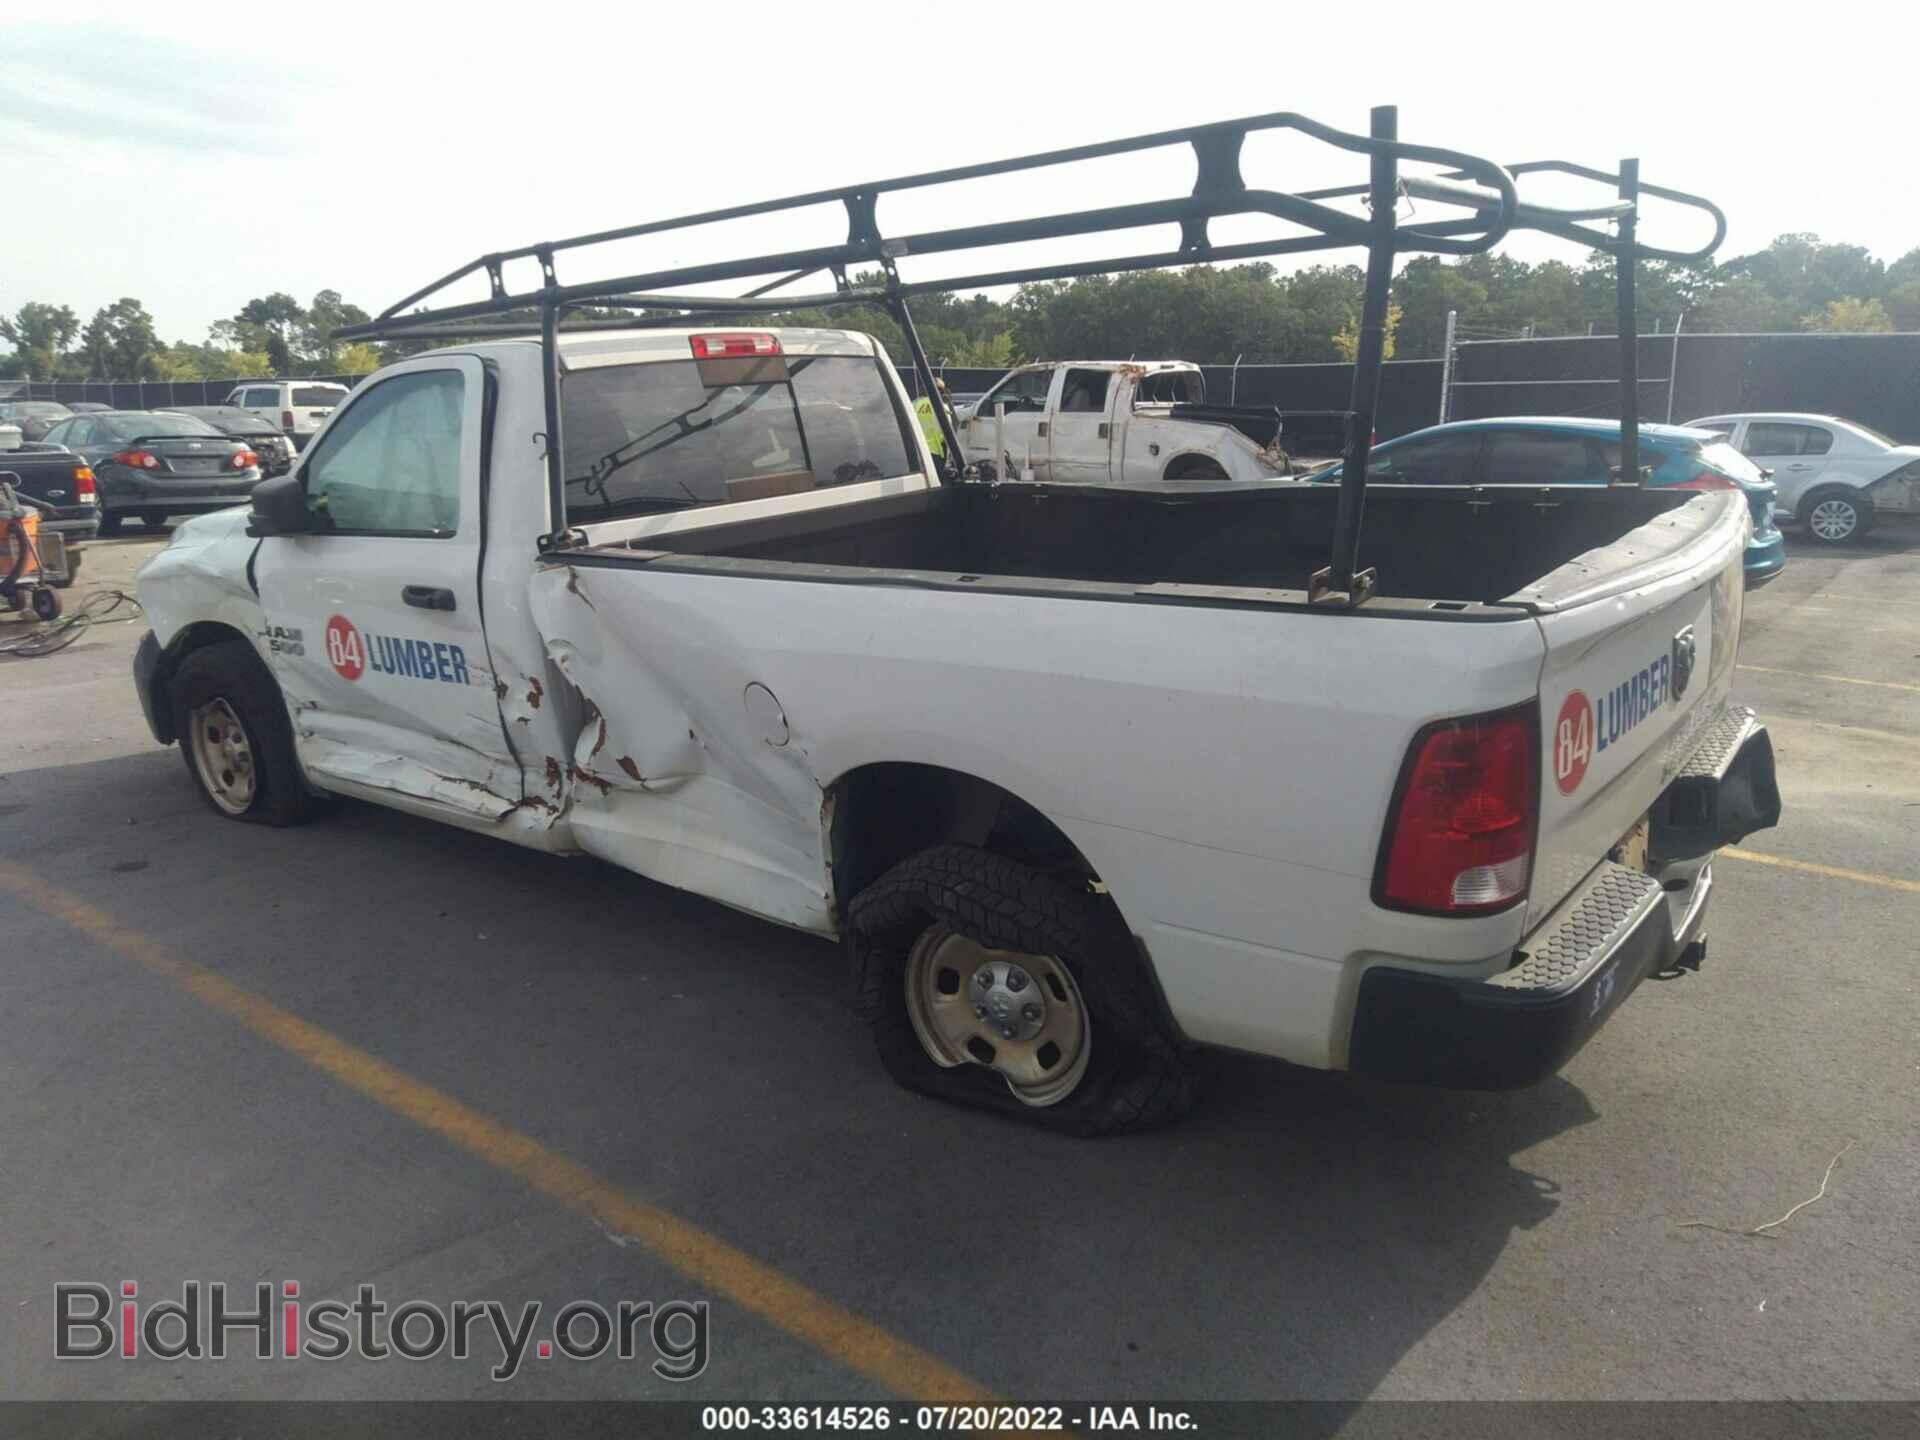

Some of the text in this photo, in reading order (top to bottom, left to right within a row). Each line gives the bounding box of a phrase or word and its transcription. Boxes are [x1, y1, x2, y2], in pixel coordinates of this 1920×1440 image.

[328, 627, 471, 685] 84 LUMBER
[1558, 654, 1669, 780] 84 LUMBER
